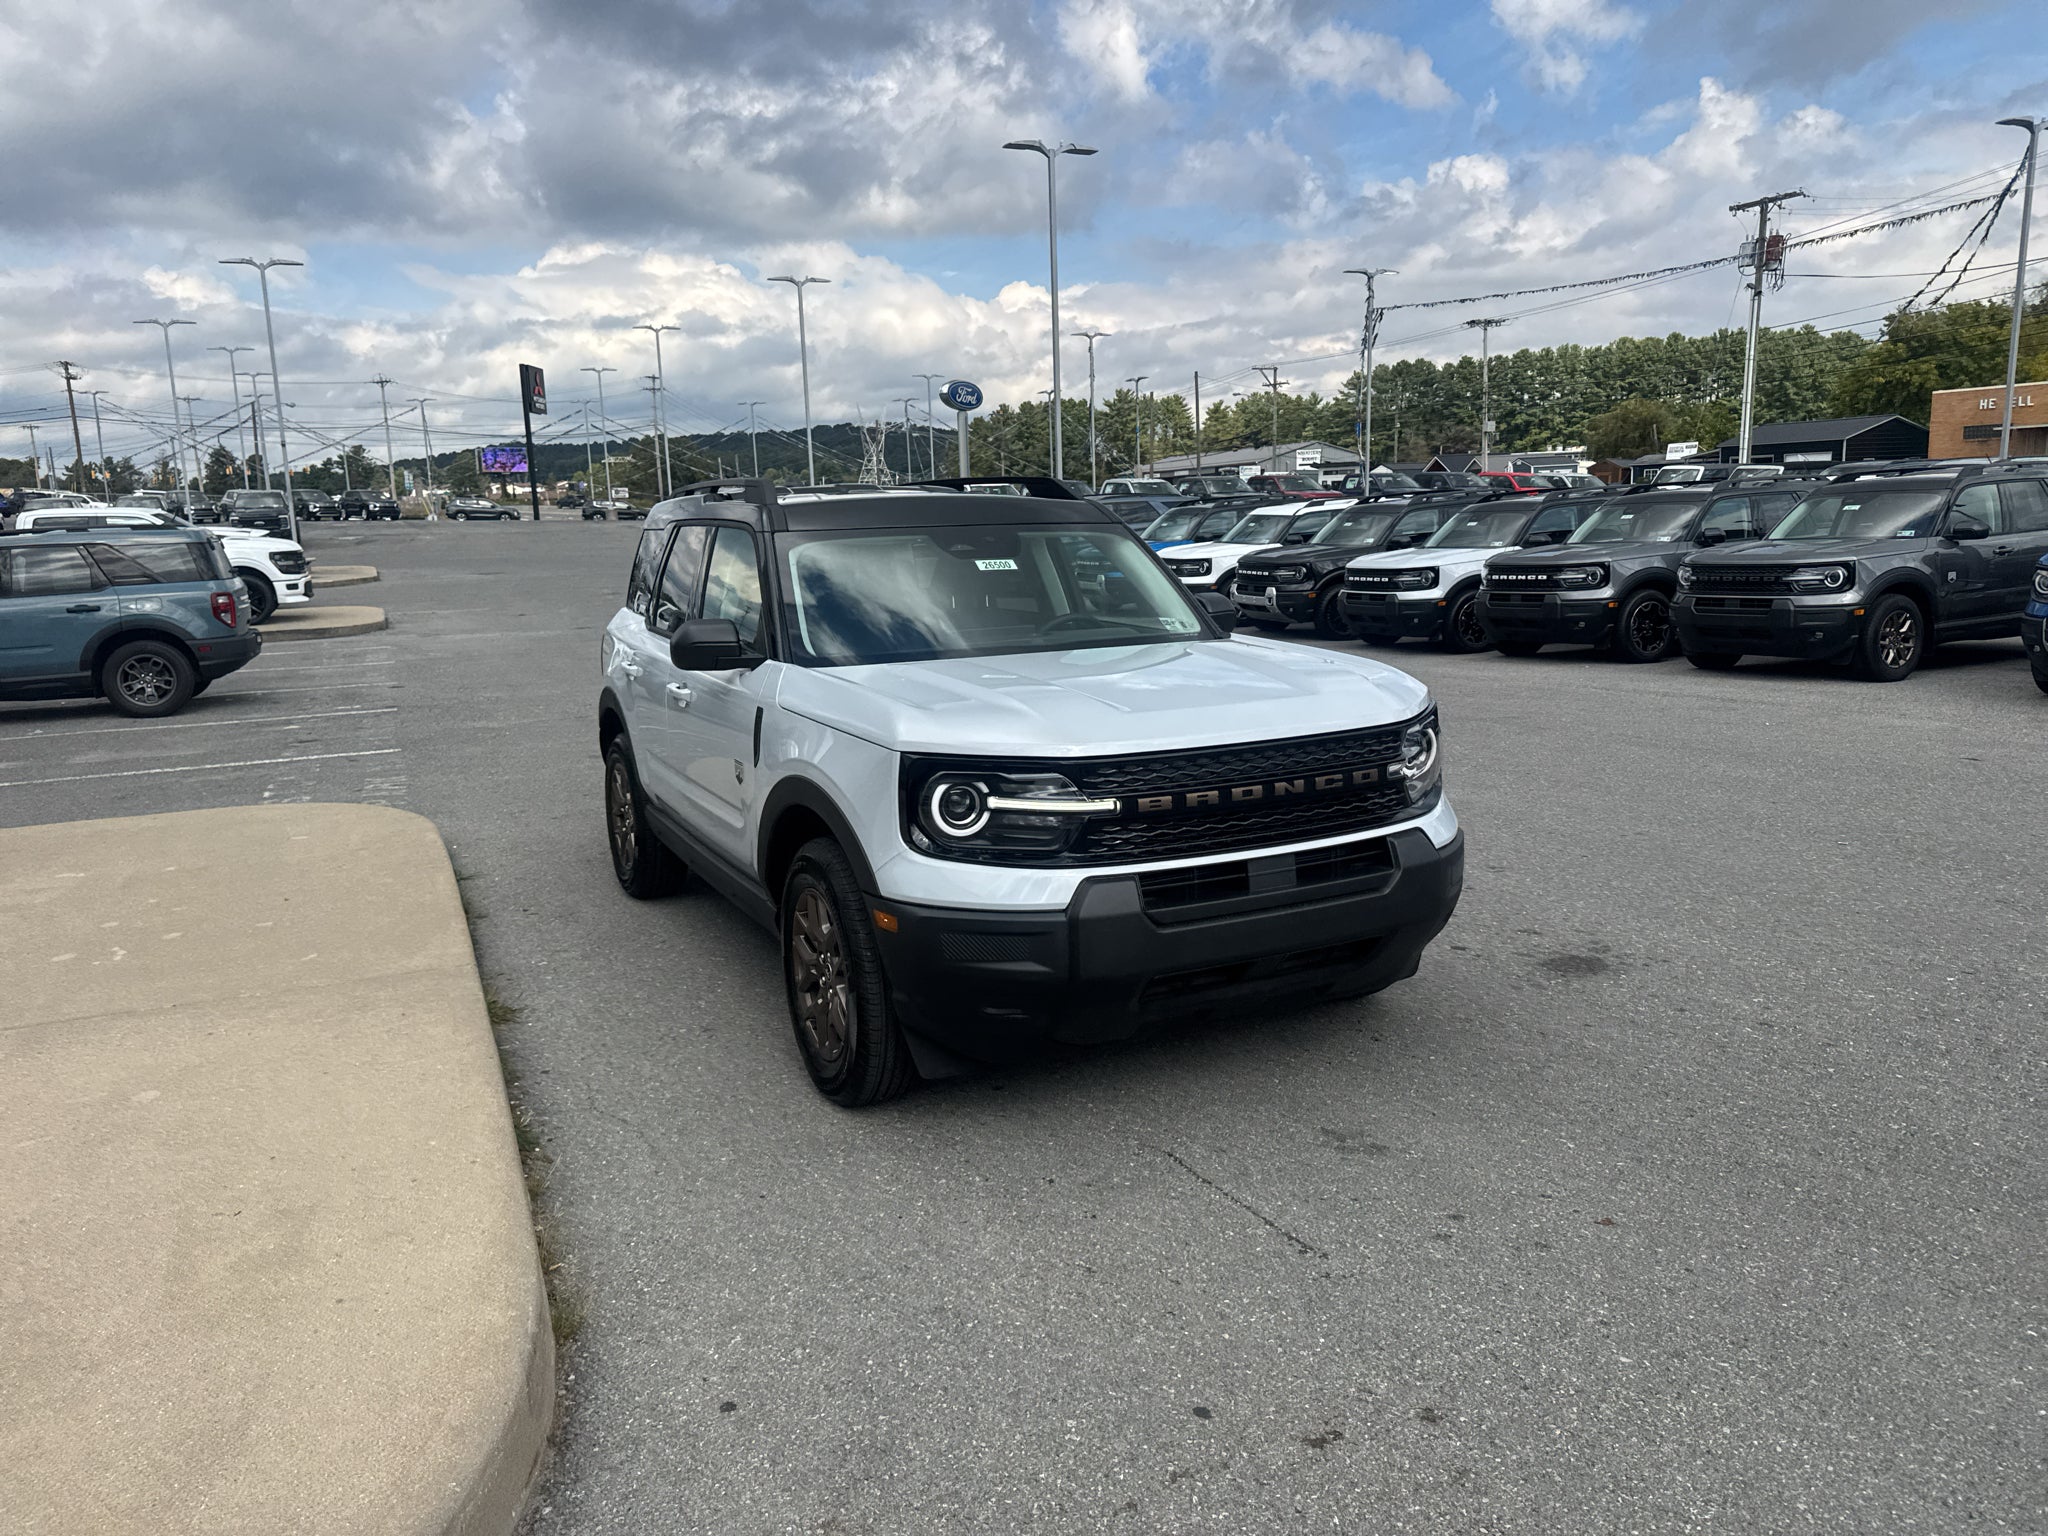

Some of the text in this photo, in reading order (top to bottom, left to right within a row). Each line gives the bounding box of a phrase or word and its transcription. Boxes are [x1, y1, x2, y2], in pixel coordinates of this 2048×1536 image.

[956, 386, 978, 404] Ford
[1979, 395, 2035, 410] HEELL
[982, 561, 1012, 569] 26500
[1137, 768, 1379, 812] BRONCO
